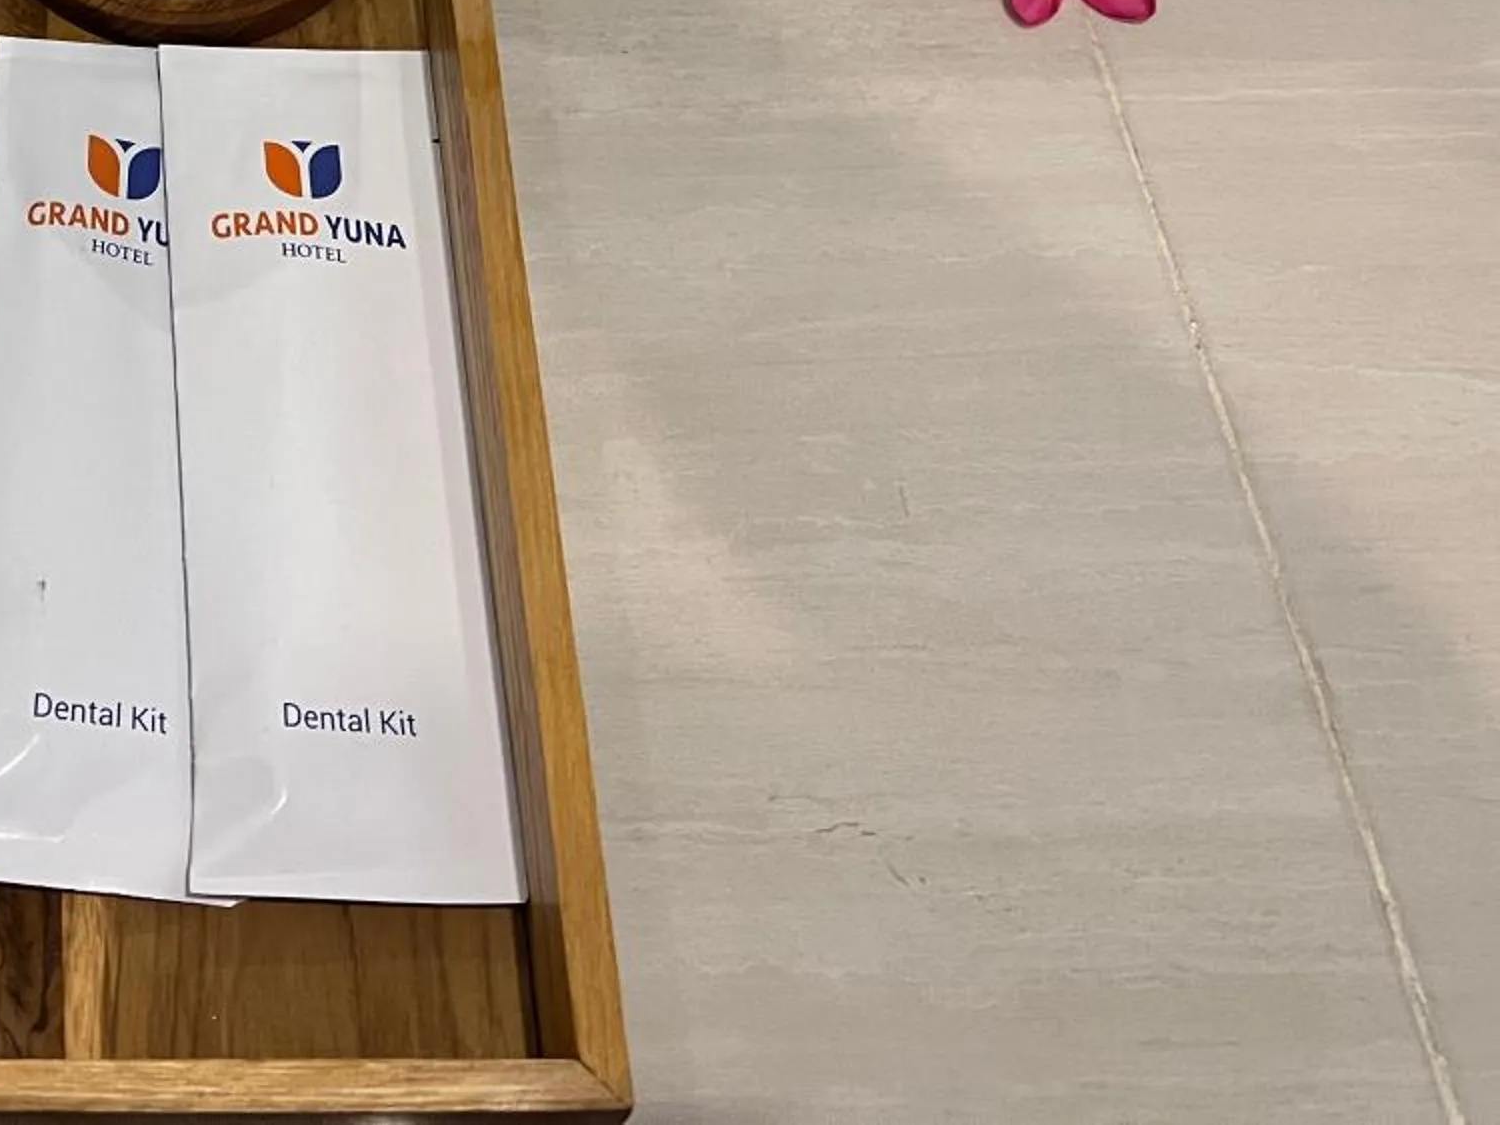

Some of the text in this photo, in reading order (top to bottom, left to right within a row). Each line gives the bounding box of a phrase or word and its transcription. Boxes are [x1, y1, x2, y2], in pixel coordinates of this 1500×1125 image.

[27, 201, 169, 247] GRAND YU
[212, 211, 407, 249] GRAND YUNA
[92, 238, 154, 266] HOTEL
[281, 241, 346, 264] HOTEL
[34, 692, 167, 735] Dental Kit
[283, 702, 417, 738] Dental Kit
